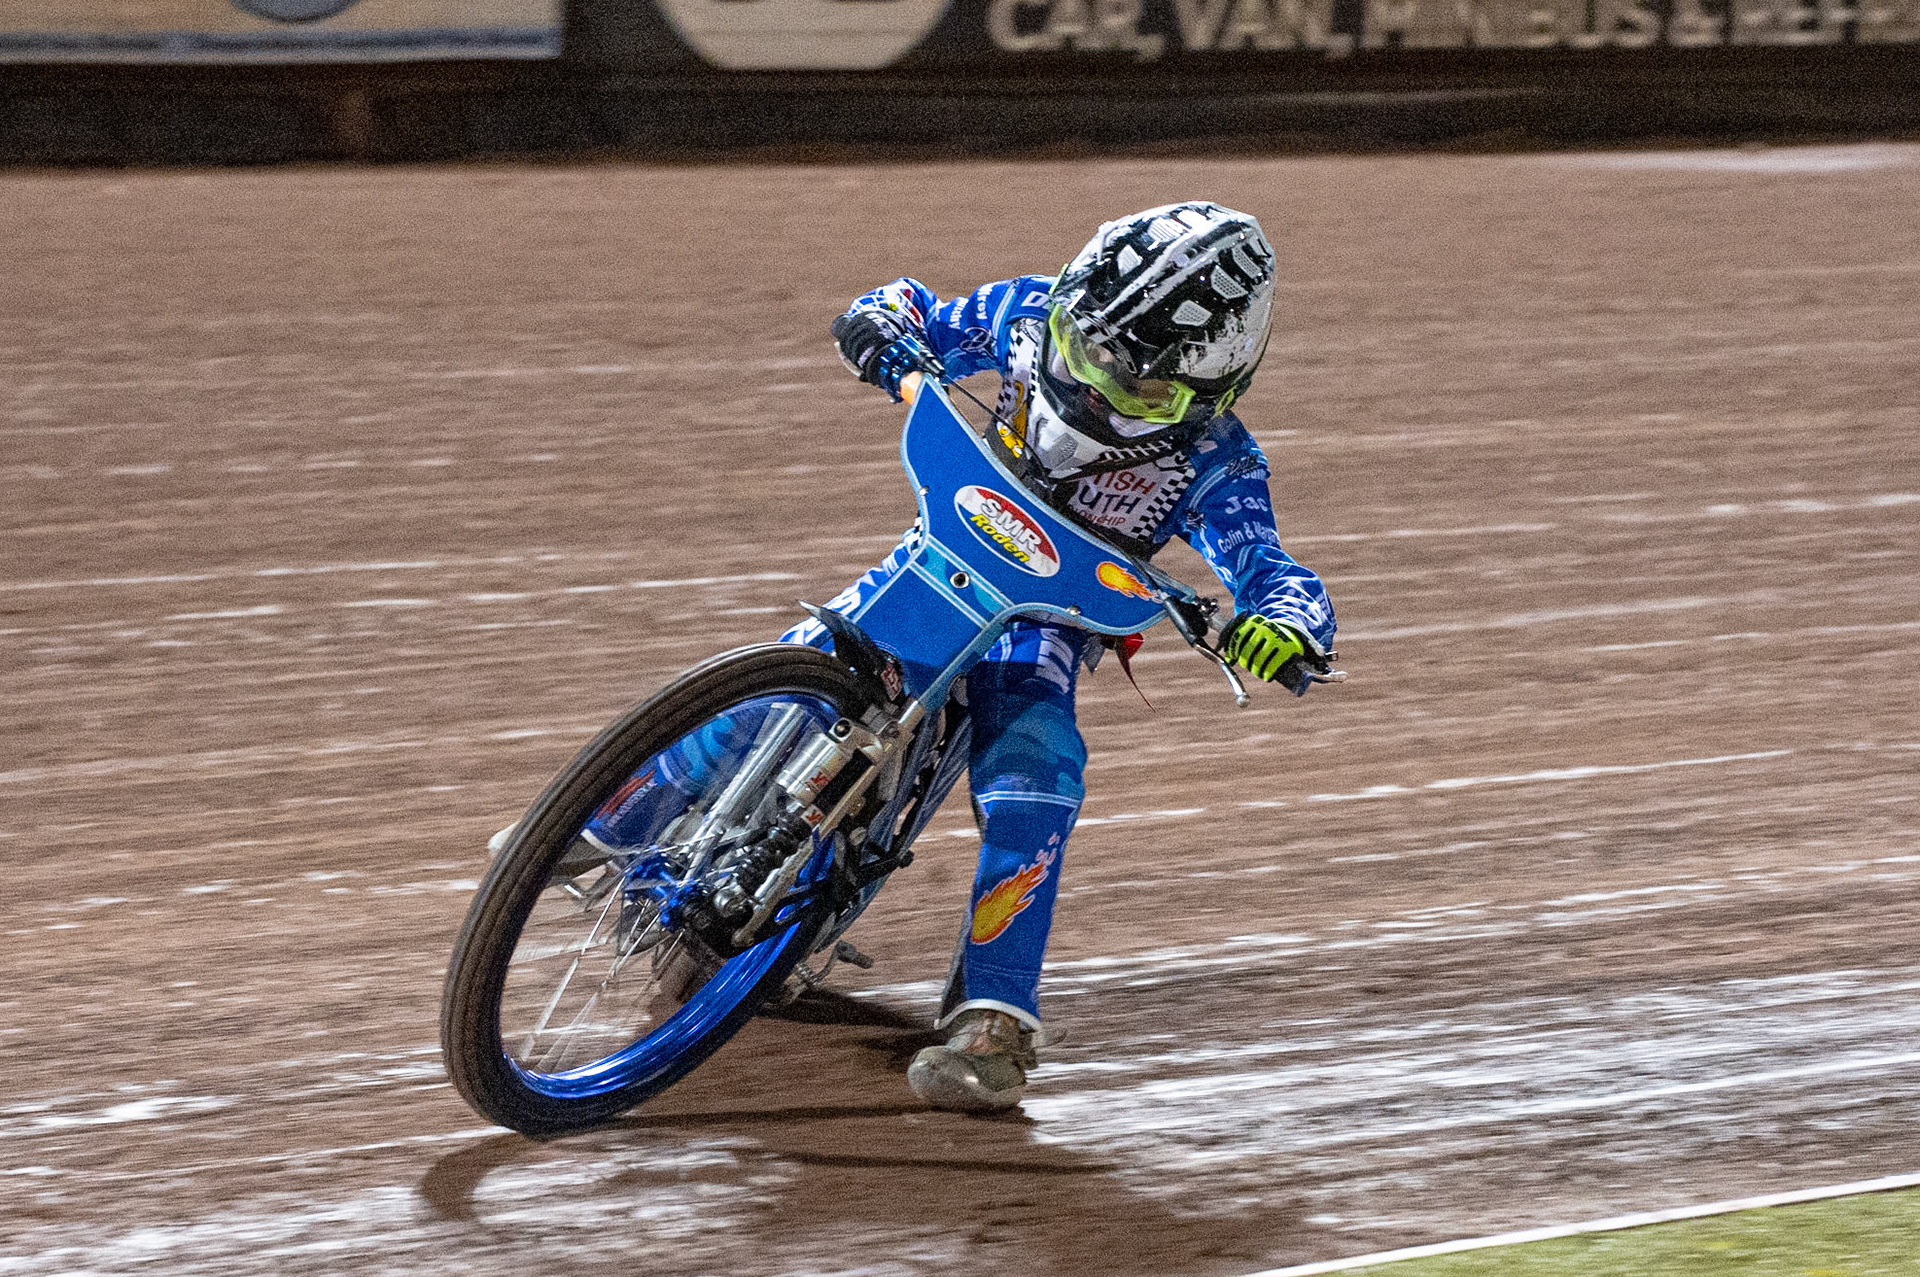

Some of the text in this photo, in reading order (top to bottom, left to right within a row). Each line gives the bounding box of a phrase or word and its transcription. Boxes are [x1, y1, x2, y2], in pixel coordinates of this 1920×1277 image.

[969, 514, 1030, 563] Roden
[980, 498, 1043, 554] SMR
[1217, 528, 1245, 554] Colin
[1243, 522, 1255, 540] &
